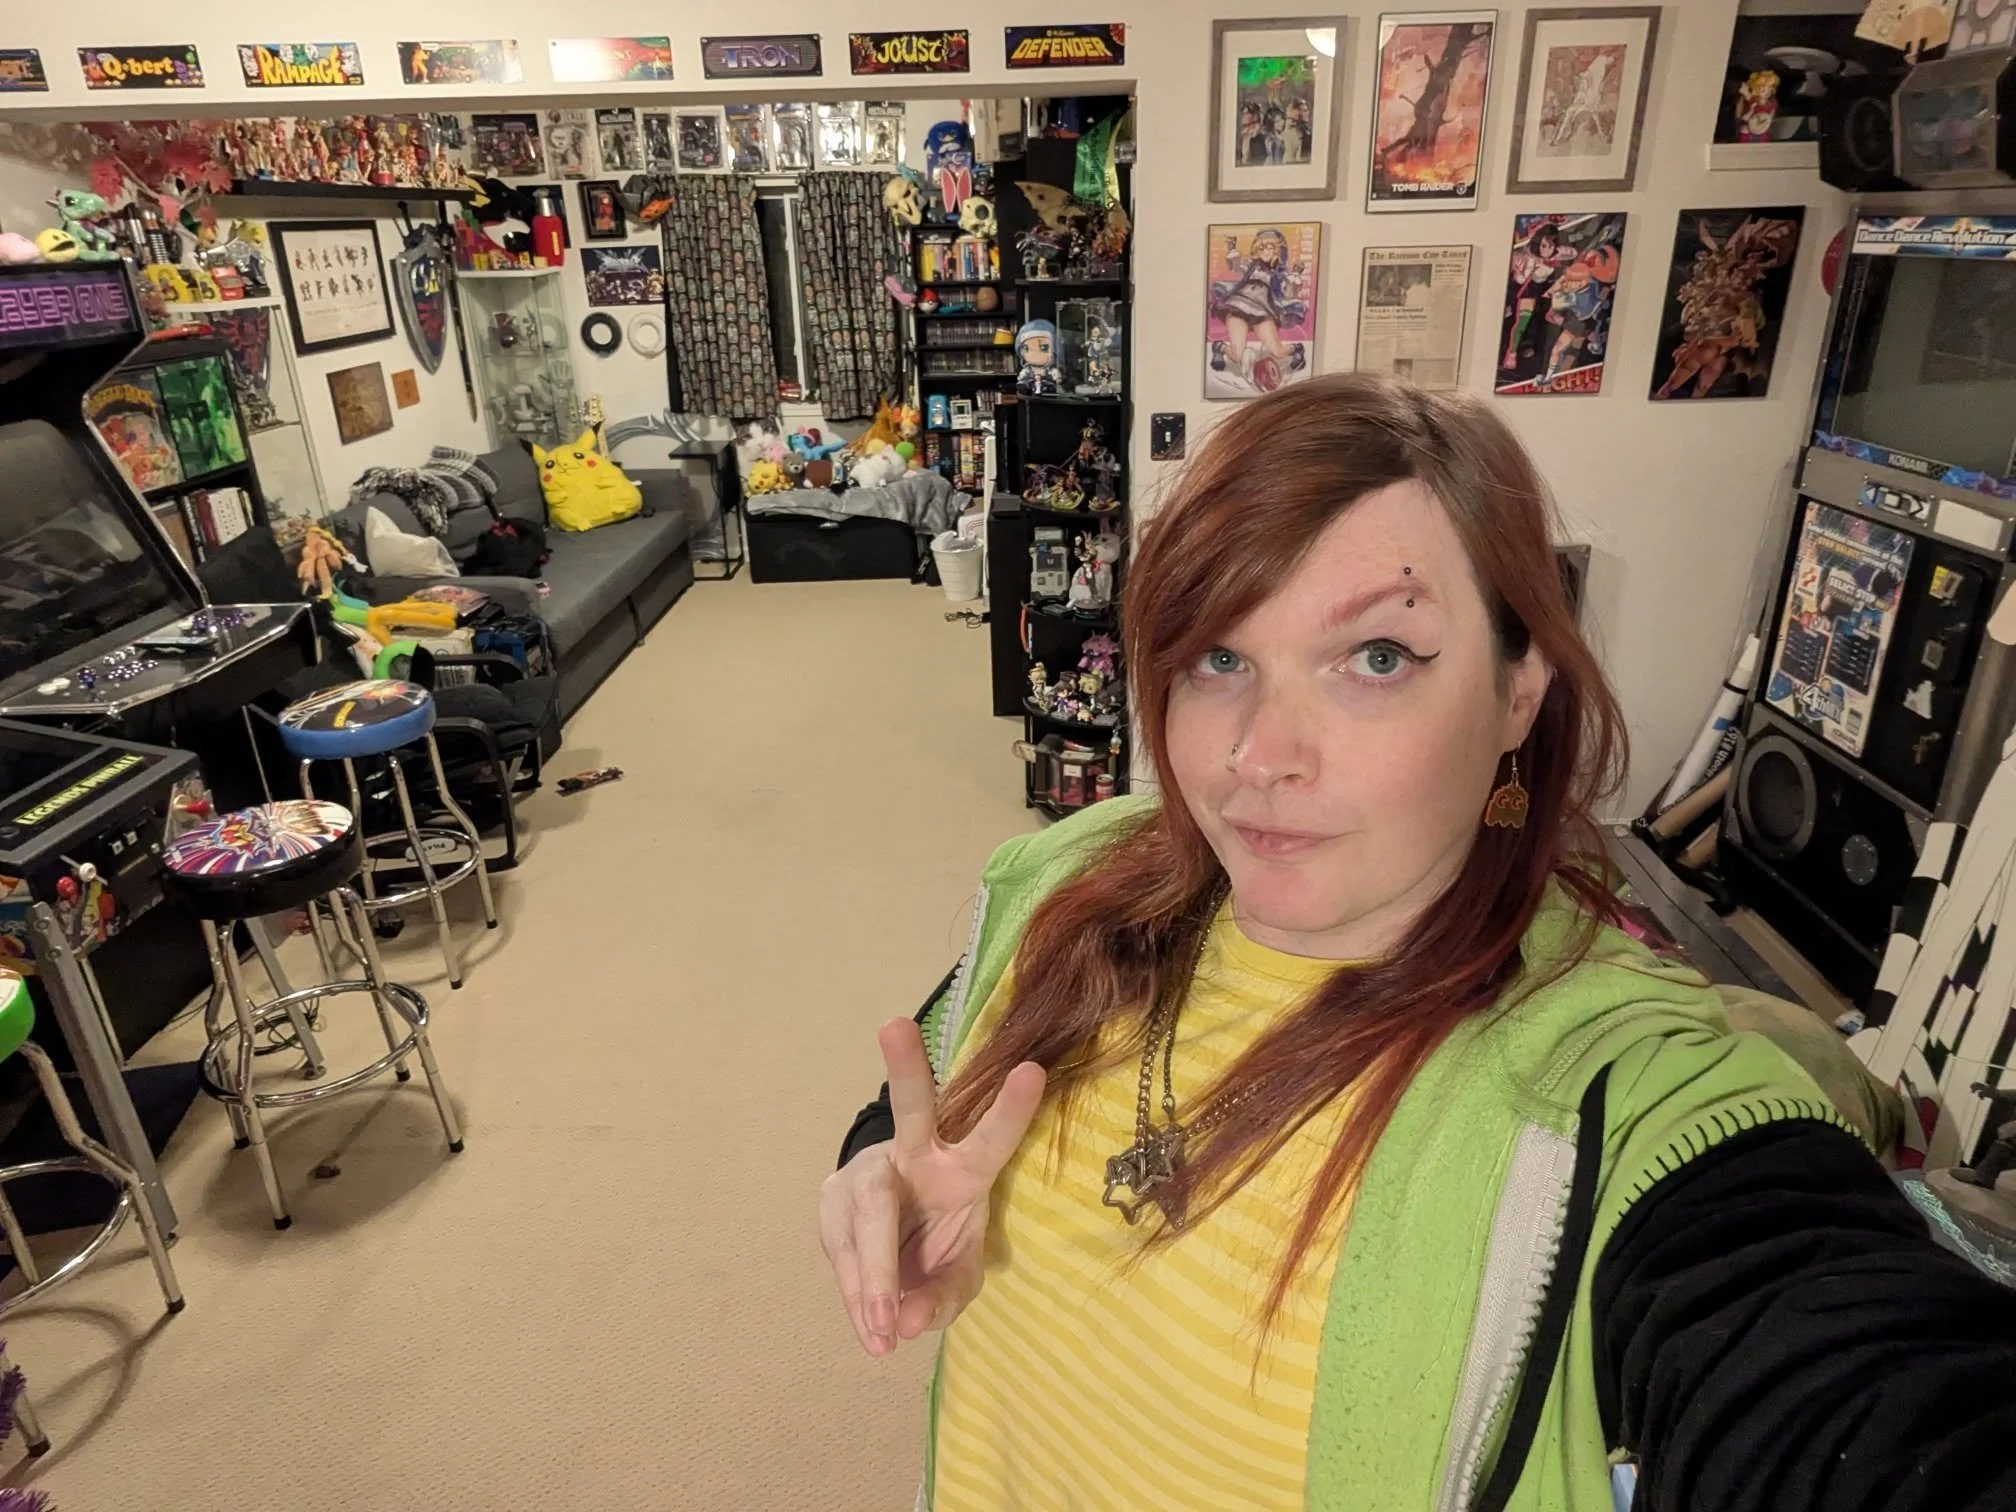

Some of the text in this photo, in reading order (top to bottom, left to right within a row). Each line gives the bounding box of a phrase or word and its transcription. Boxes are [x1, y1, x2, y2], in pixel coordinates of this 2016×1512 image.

[720, 44, 800, 68] TRON
[877, 35, 942, 63] JOUST
[1011, 36, 1113, 59] DEFENDER
[255, 44, 345, 84] RAMPAGE
[1391, 183, 1455, 192] TOMB RAIDER
[1859, 229, 1894, 242] Dance
[1895, 229, 1931, 243] Dance
[1369, 252, 1385, 260] The
[1423, 251, 1440, 259] City
[1442, 250, 1468, 258] Times
[1888, 453, 1929, 474] KONAMI
[15, 755, 145, 825] LEGENDS PINBALL
